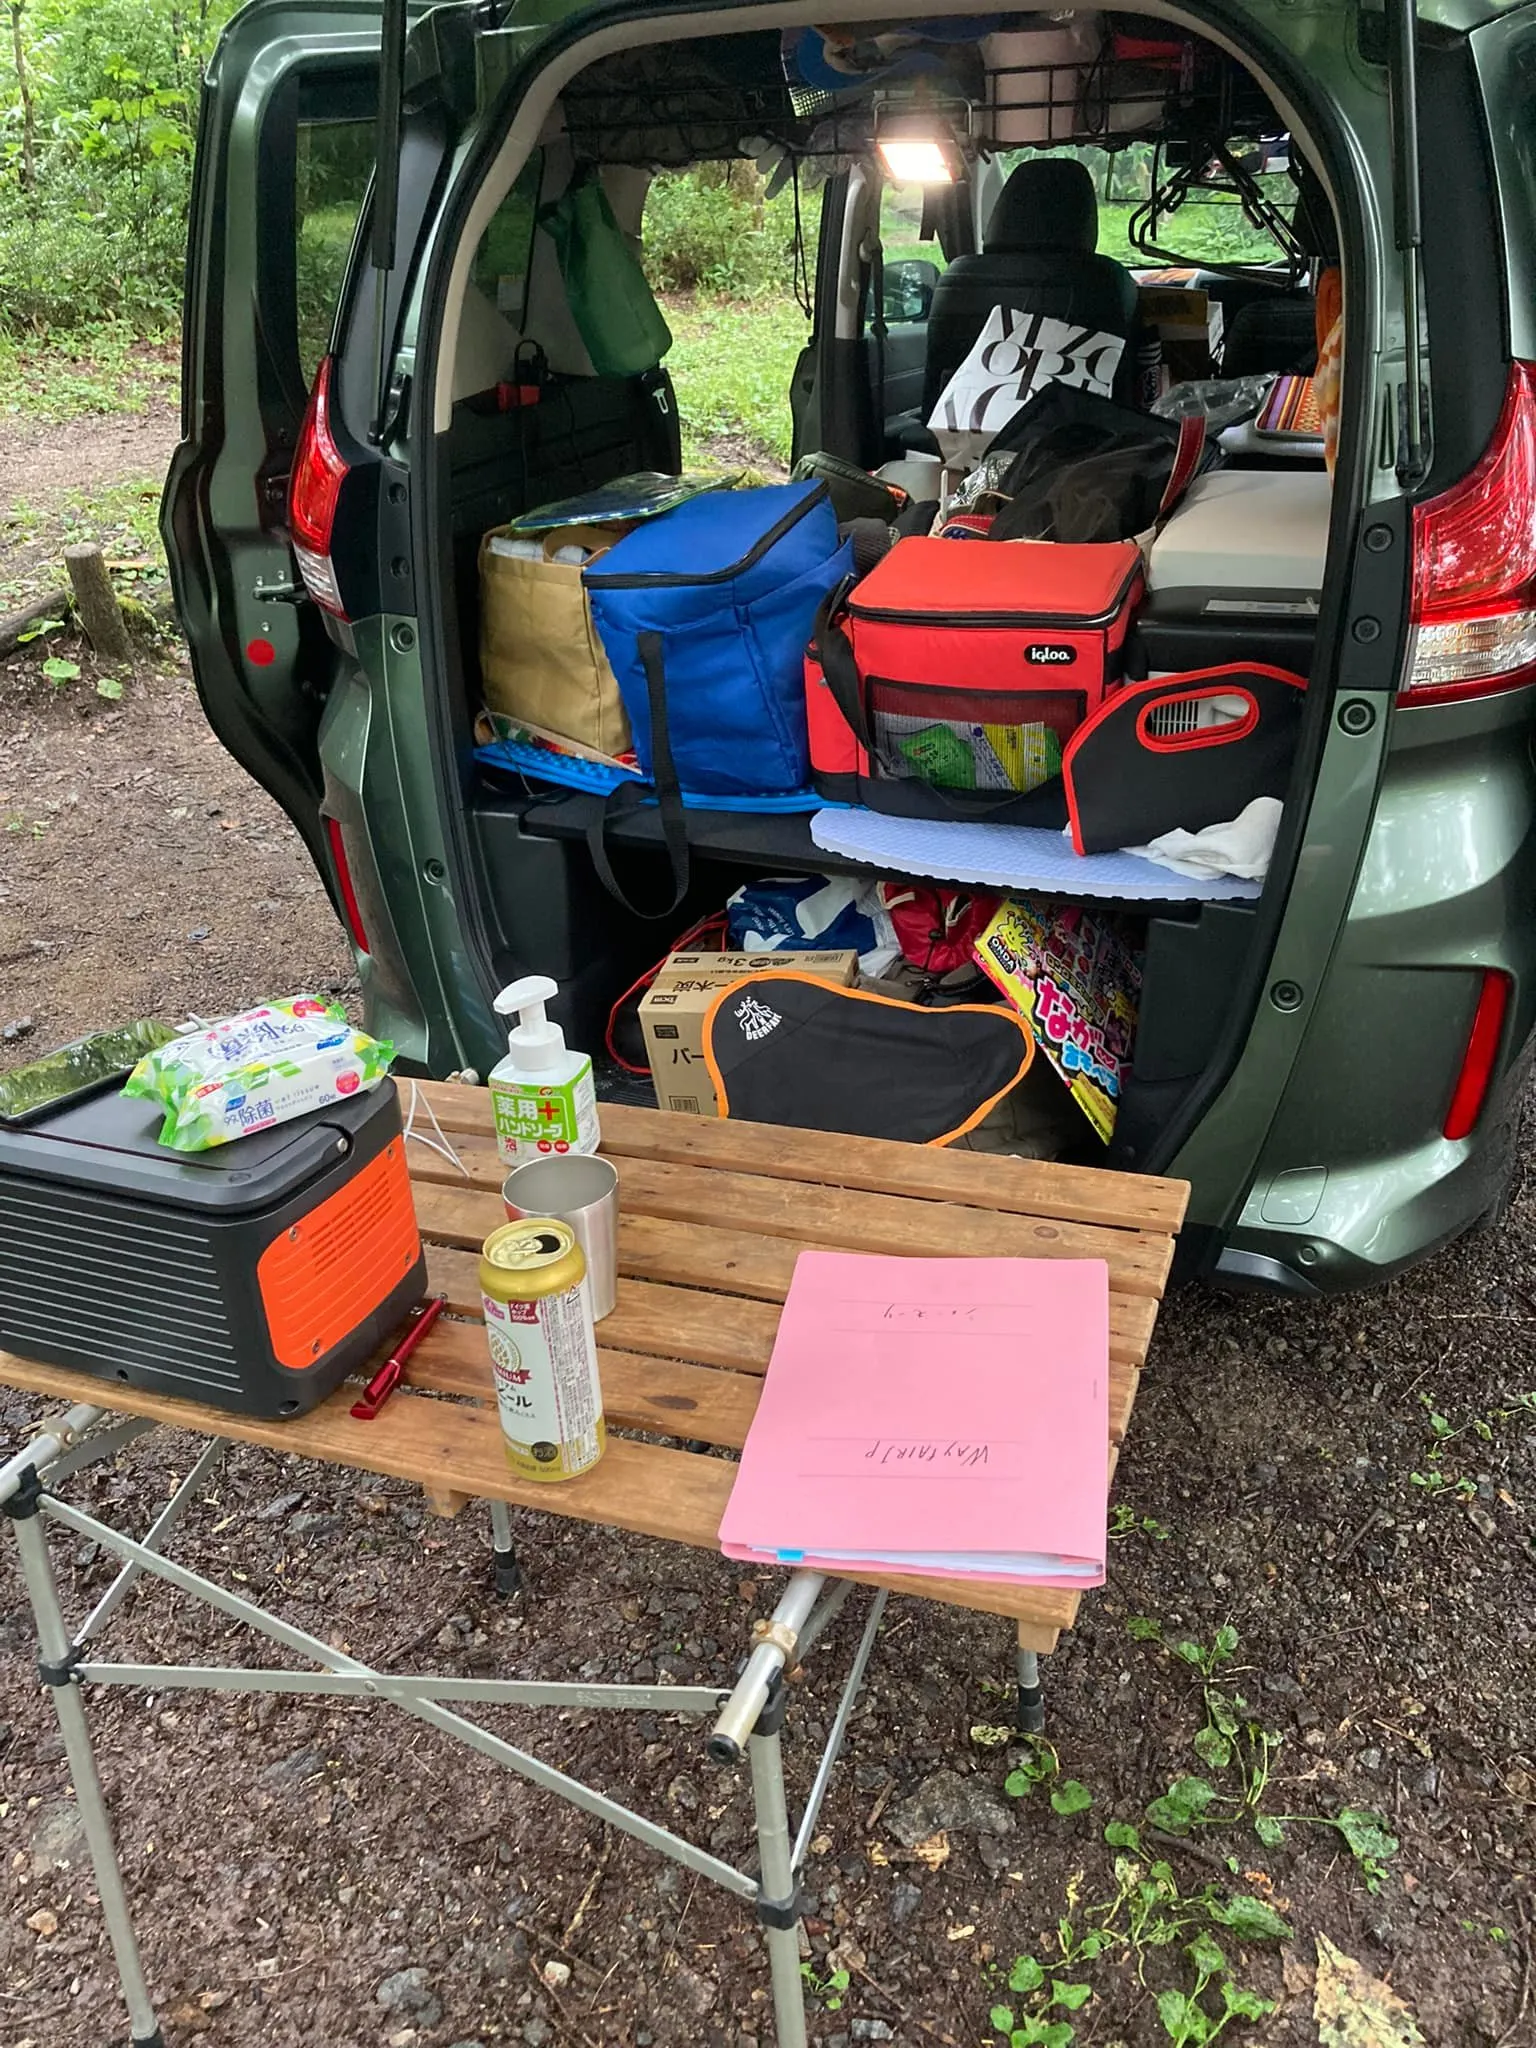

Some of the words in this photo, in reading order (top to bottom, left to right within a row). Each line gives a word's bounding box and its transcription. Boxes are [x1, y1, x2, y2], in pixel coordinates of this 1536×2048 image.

[991, 938, 1014, 969] ONDA
[239, 1098, 274, 1127] 除菌
[495, 1095, 538, 1121] 薬用
[499, 1117, 563, 1138] ハンドソープ
